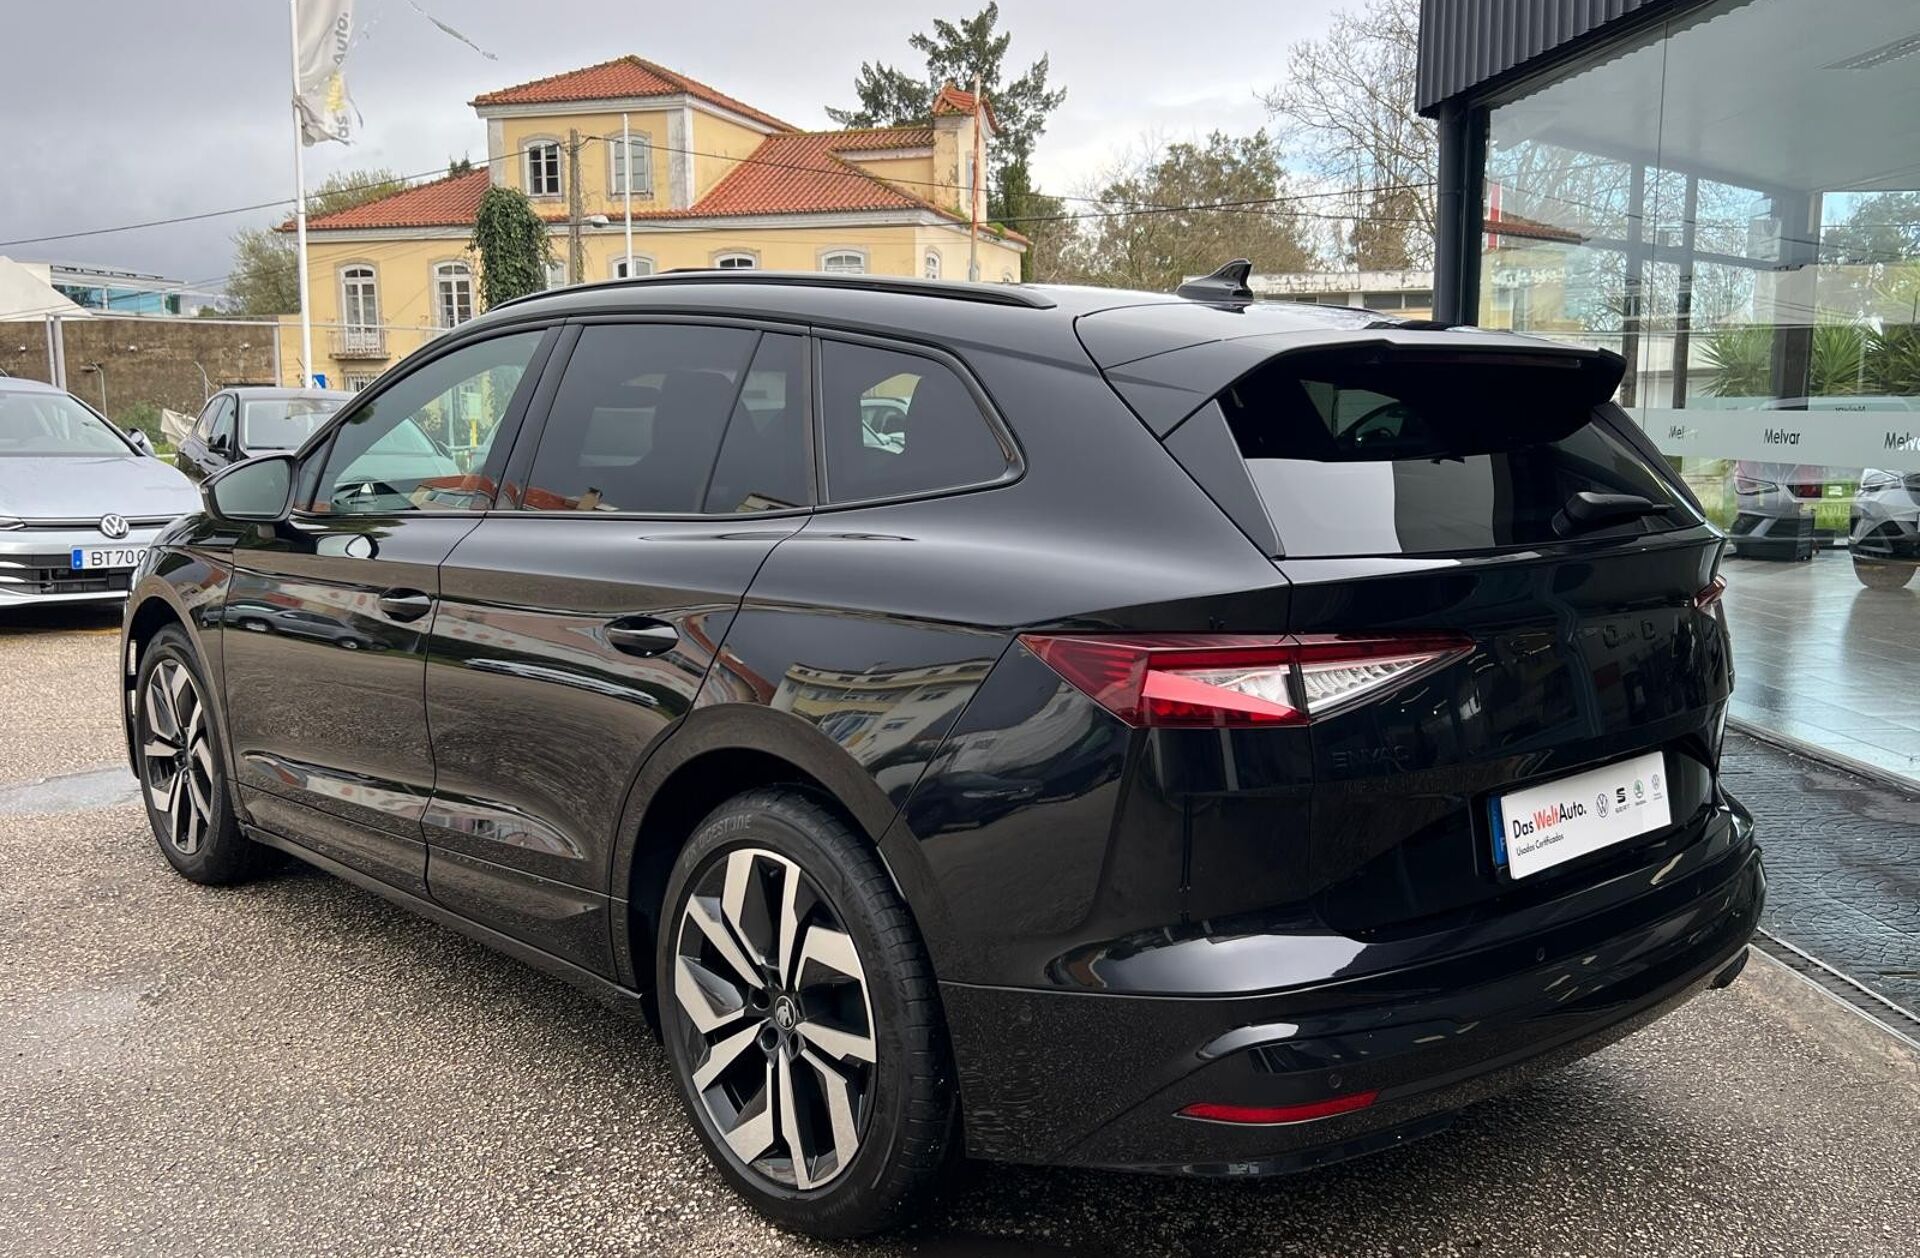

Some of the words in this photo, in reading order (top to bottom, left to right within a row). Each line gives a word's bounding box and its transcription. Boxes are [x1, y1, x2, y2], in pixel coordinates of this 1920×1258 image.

[1763, 428, 1800, 445] Melvar
[91, 551, 112, 566] BT
[116, 550, 134, 565] 70
[1512, 819, 1534, 839] Das
[1534, 802, 1587, 831] WeltAuto.
[1516, 843, 1536, 857] Usados
[1535, 833, 1565, 850] Certificados
